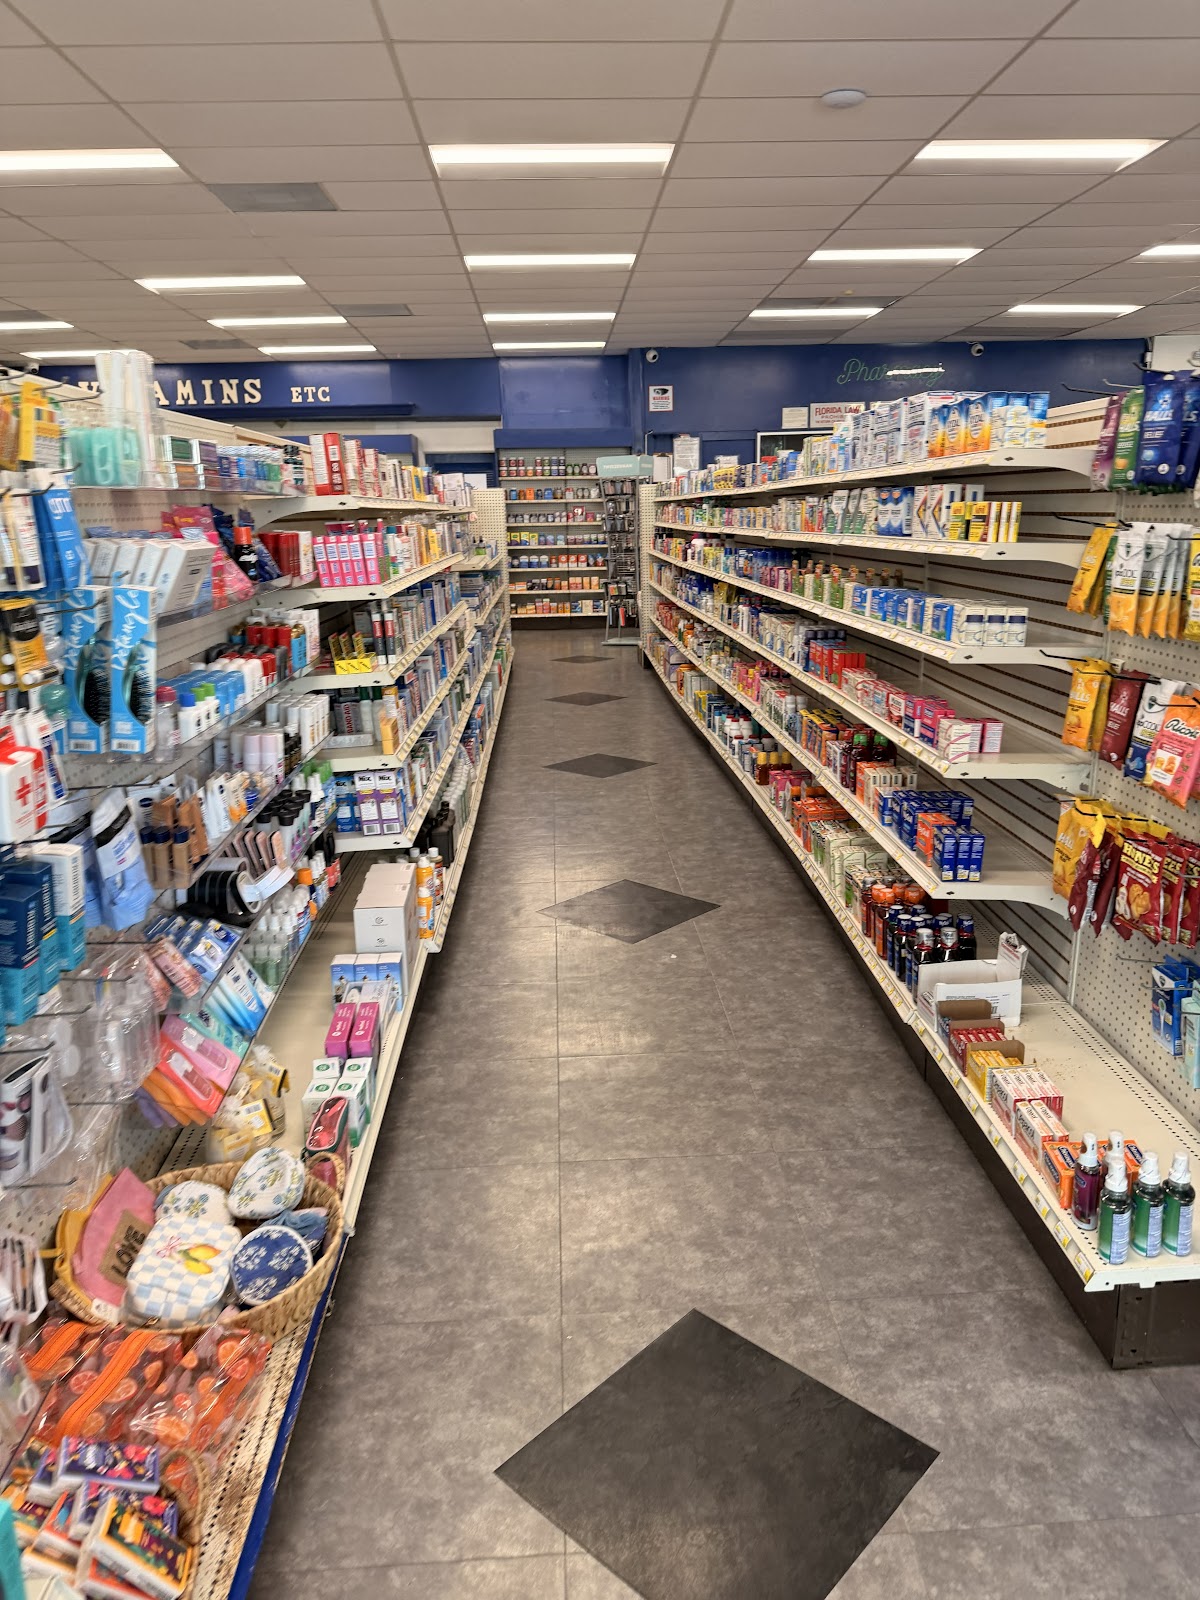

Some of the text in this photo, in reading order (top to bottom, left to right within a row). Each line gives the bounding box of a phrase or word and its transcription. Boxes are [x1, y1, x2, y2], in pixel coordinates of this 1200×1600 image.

[290, 386, 331, 403] ETC
[815, 406, 842, 416] FLORIDA
[111, 1224, 147, 1279] LOVE
